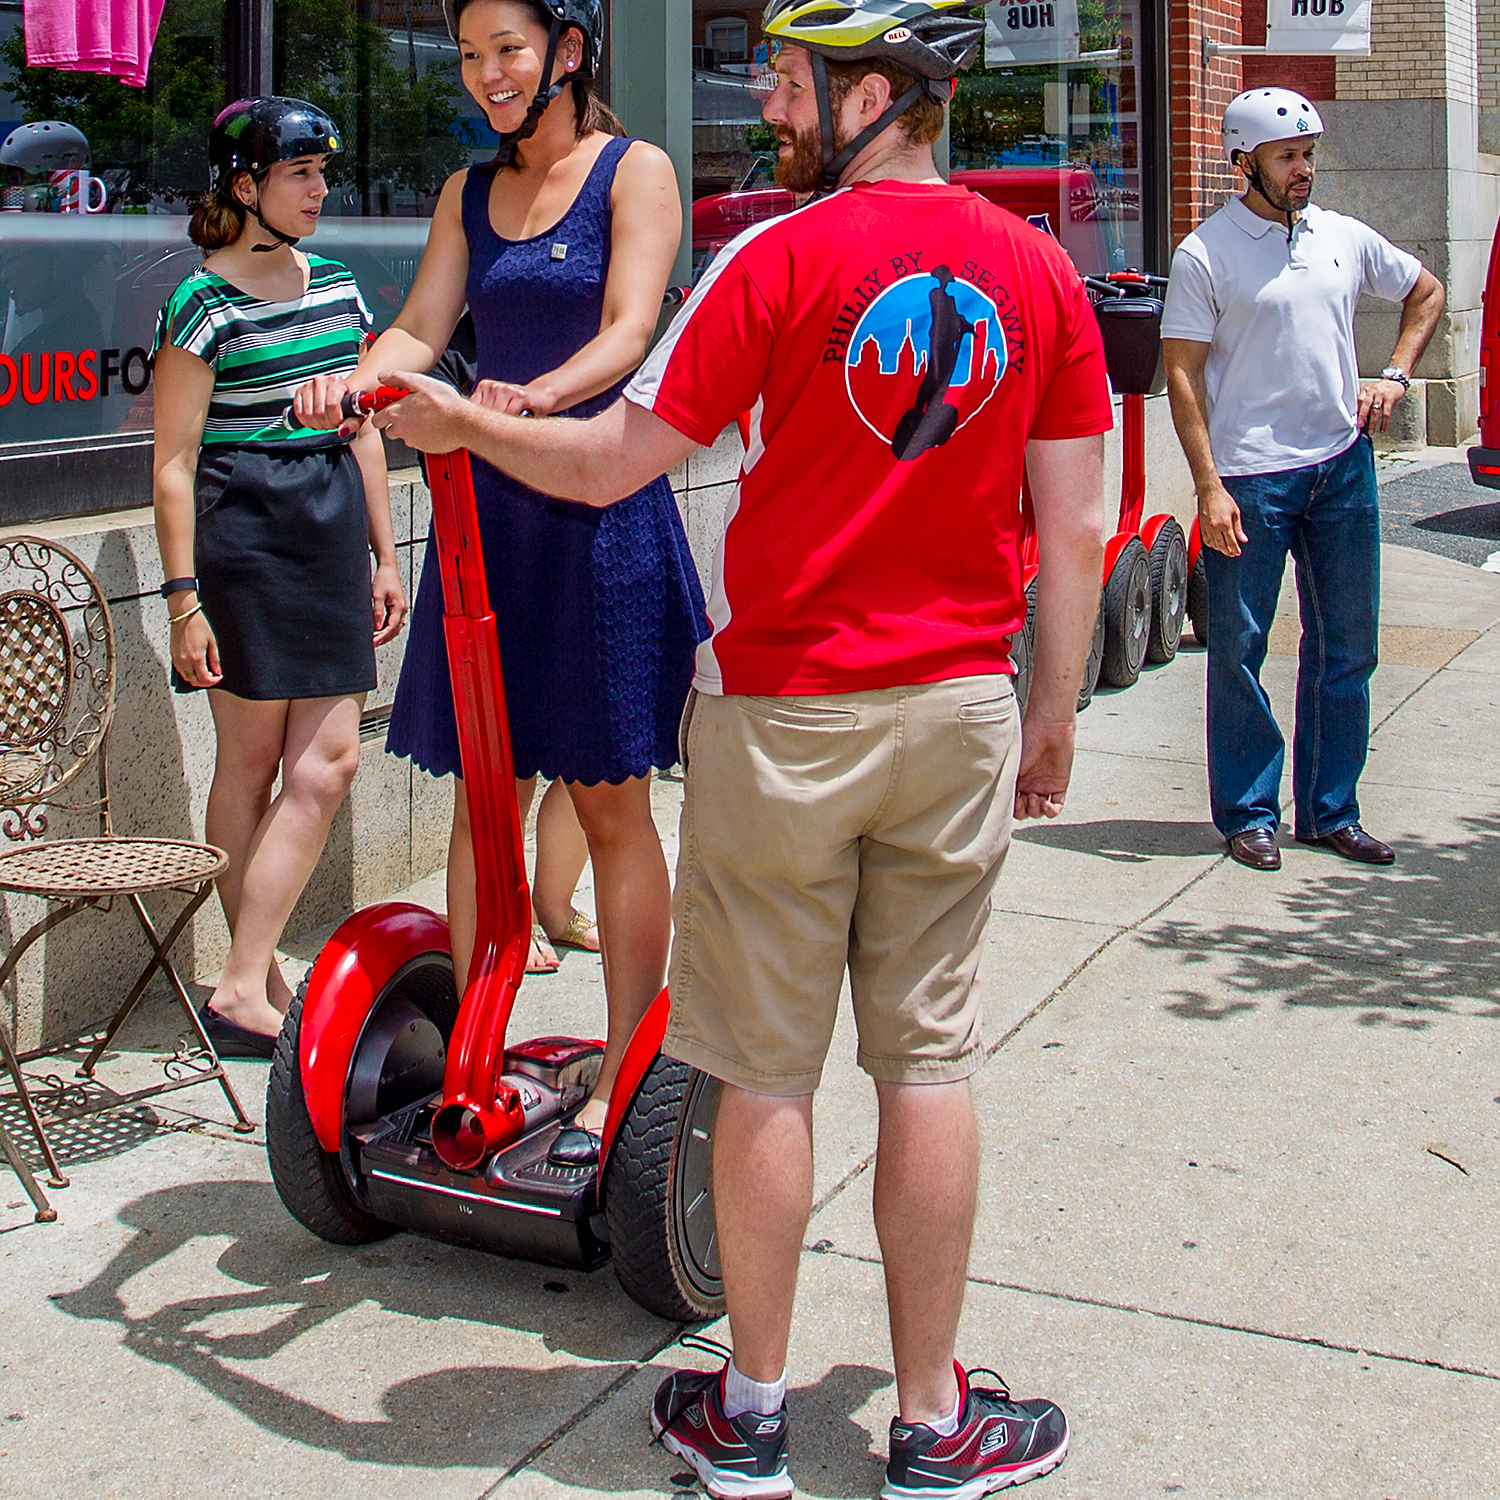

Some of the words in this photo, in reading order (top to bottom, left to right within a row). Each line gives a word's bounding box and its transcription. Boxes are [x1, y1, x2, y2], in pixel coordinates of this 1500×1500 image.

[888, 31, 907, 40] BELL
[823, 268, 885, 364] PHILLY
[890, 251, 922, 277] BY
[960, 261, 1024, 375] SEGWAY
